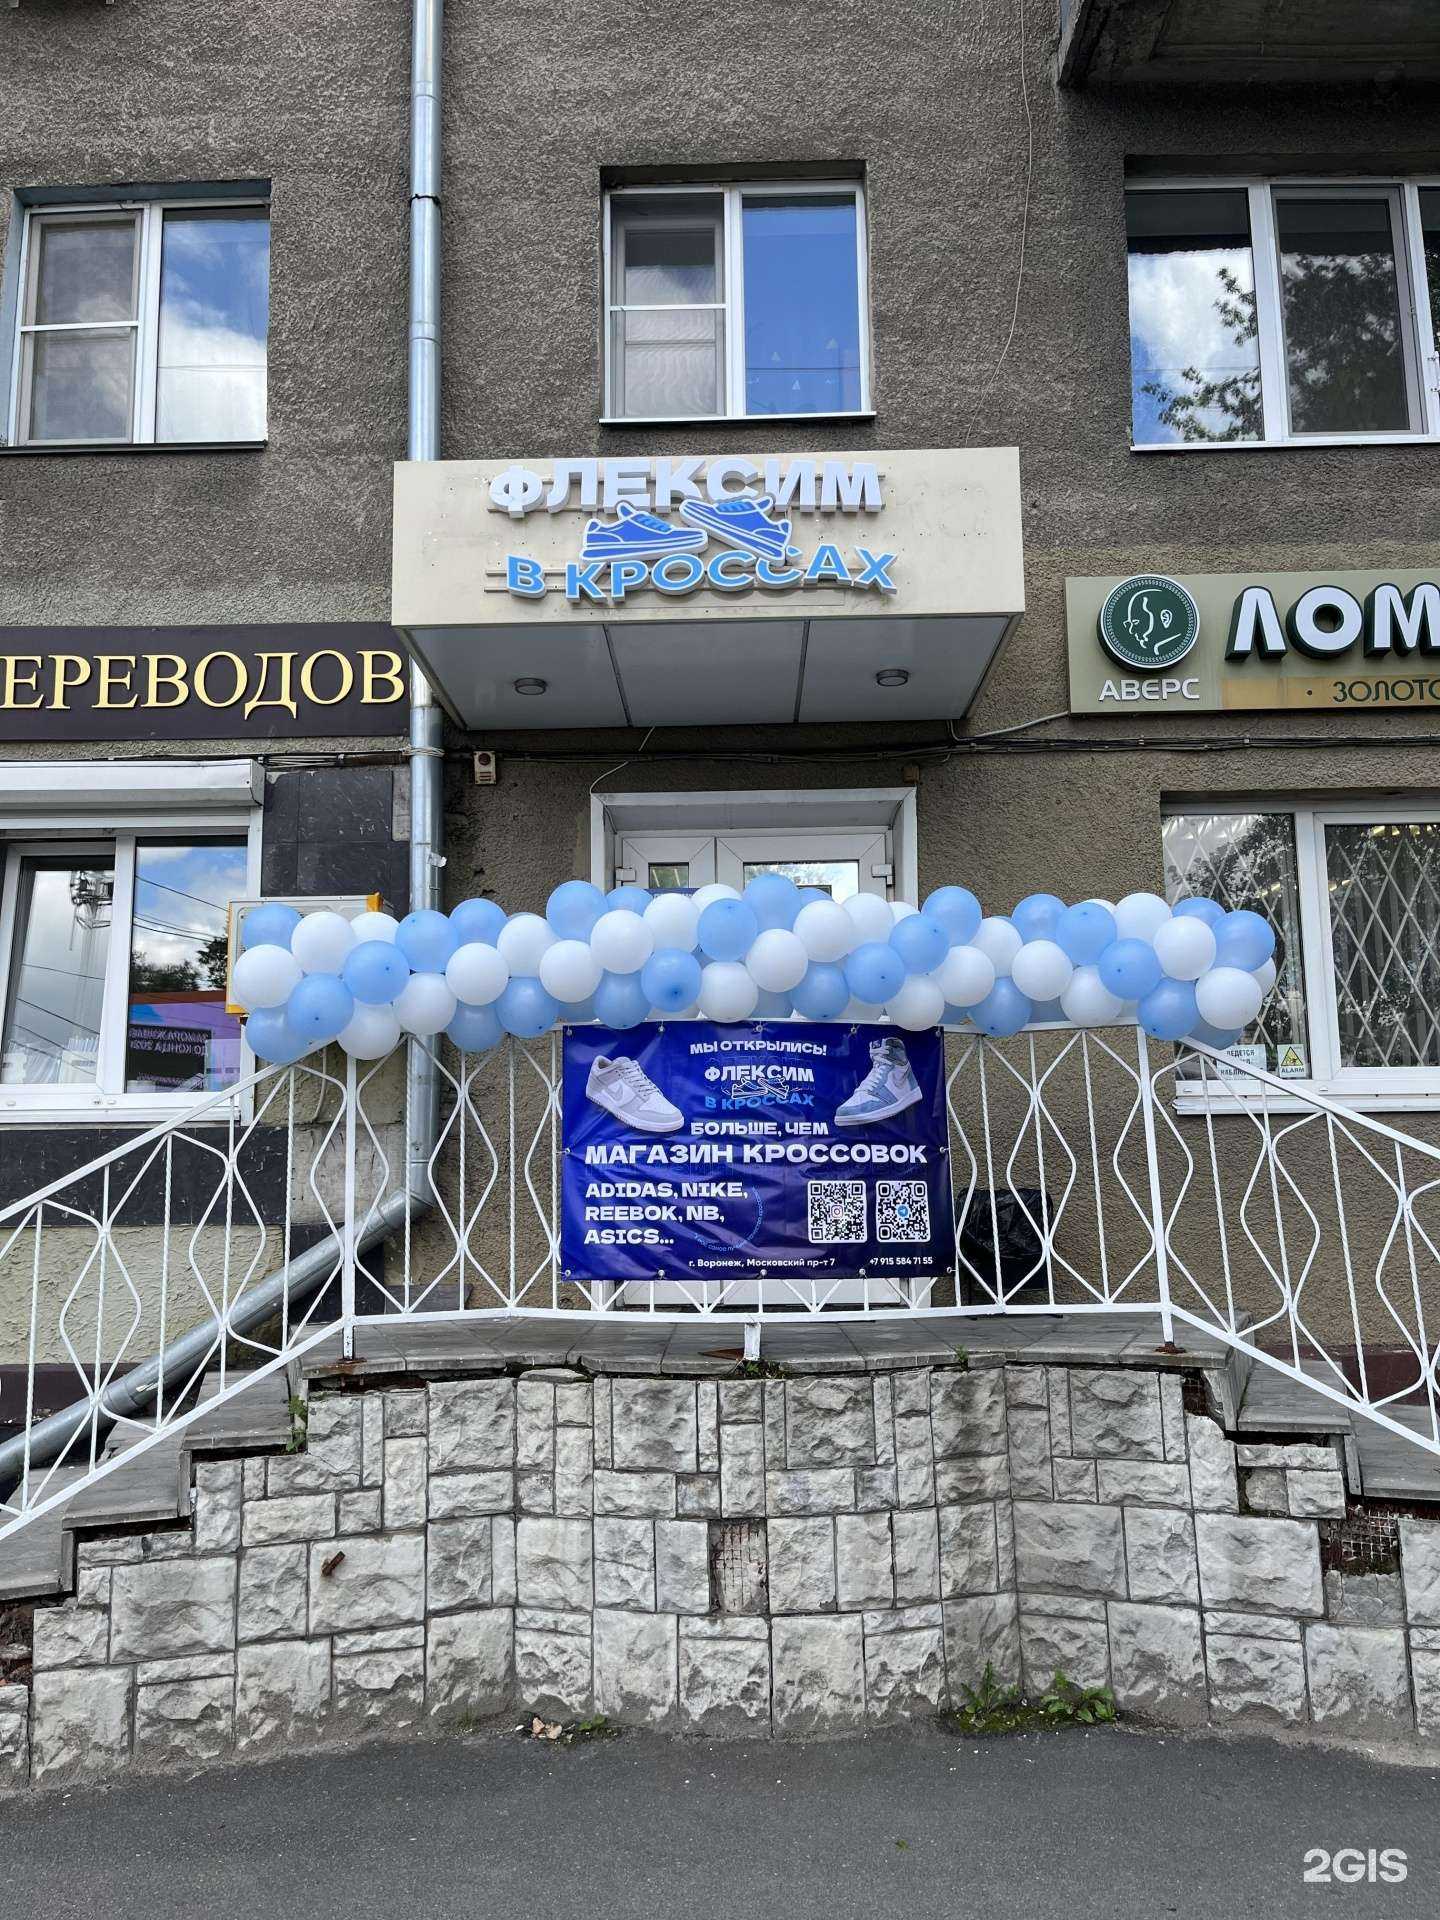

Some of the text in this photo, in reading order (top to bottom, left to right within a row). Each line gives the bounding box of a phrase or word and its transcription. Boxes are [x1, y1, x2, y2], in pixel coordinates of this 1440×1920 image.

[488, 458, 884, 518] ФЛЕКСИМ
[505, 544, 898, 604] В КРОССАХ
[1098, 678, 1200, 702] АВЕРС
[690, 1040, 827, 1056] МЫ ОТКРЫЛИСЬ!
[704, 1064, 815, 1082] ФЛЕКСИМ
[705, 1096, 717, 1109] В
[690, 1122, 829, 1136] БОЛЬШЕ, ЧЕМ
[585, 1144, 927, 1164] МАГАЗИН КРОССОВОК
[586, 1182, 748, 1199] ADIDAS, NIKE,
[585, 1205, 725, 1222] REEBOK, NB,
[584, 1229, 674, 1245] ASICS...
[698, 1259, 744, 1268] Воронеж,
[747, 1258, 804, 1267] Московский
[807, 1260, 828, 1268] пр-т
[830, 1258, 835, 1266] 7
[869, 1257, 933, 1266] +7 915 584 71 55
